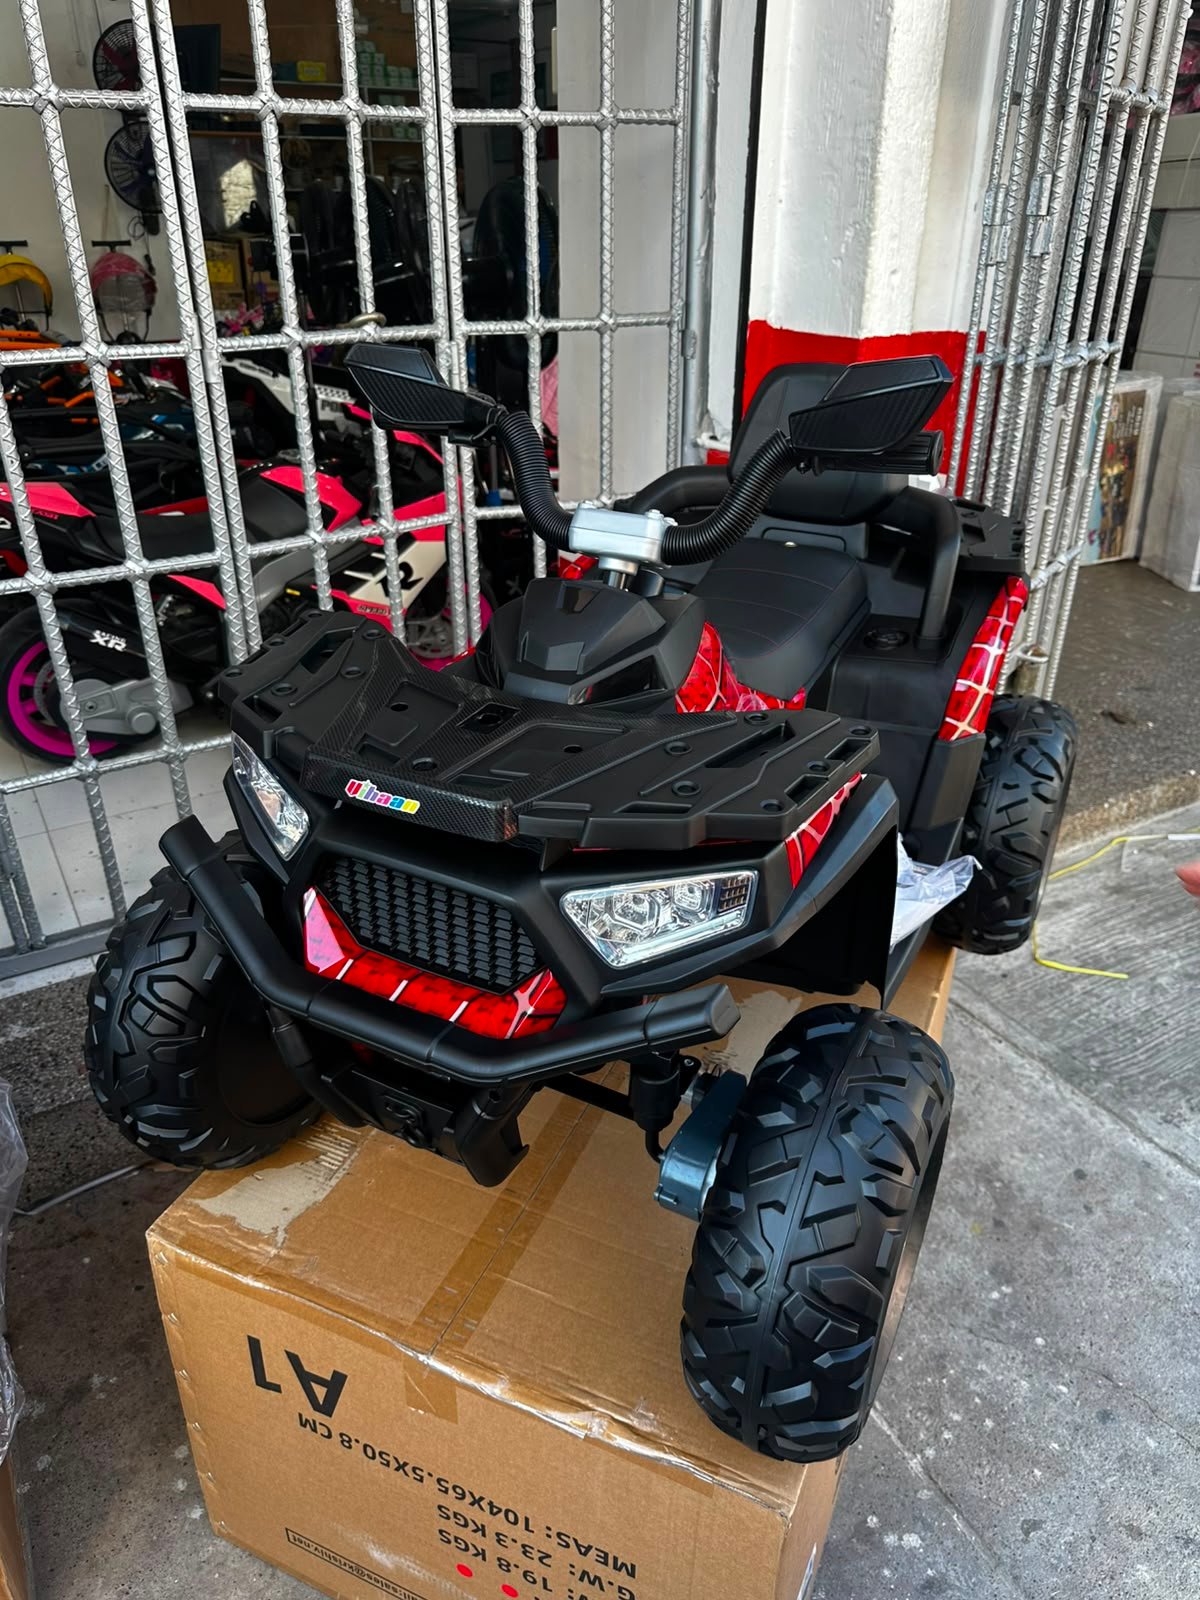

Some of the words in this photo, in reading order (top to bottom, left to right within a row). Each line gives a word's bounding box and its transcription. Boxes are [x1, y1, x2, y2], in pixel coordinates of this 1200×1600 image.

[247, 1334, 348, 1418] A1
[298, 1412, 333, 1440] CM
[339, 1430, 535, 1535] 104X65.5X50.8
[437, 1504, 487, 1538] KGS
[438, 1528, 487, 1562] KGS
[495, 1532, 553, 1568] 23.3
[545, 1526, 637, 1579] MEAS:
[291, 1533, 420, 1600] ail:sales@krishiv.net
[496, 1556, 553, 1593] 19.8
[568, 1563, 636, 1600] G.W:
